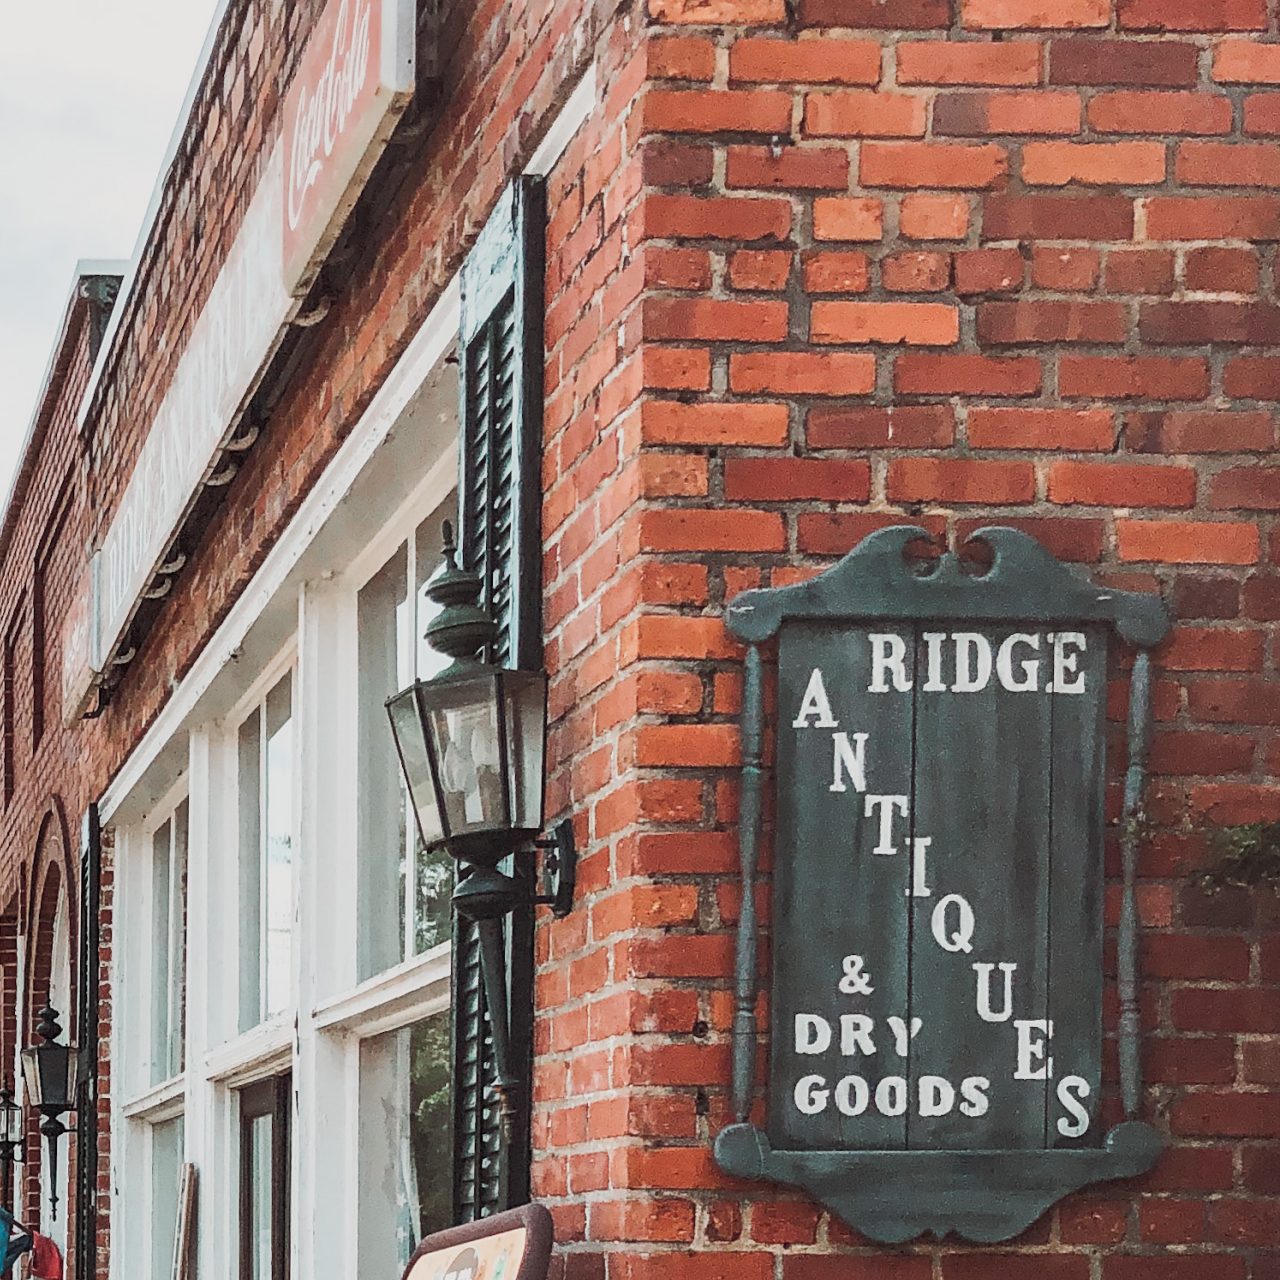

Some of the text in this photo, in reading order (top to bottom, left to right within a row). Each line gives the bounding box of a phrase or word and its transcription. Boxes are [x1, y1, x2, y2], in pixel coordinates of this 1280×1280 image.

[869, 632, 1086, 694] RIDGE
[793, 668, 1090, 1138] ANTIQUES
[838, 955, 874, 995] &
[795, 1014, 922, 1056] DRY
[794, 1075, 990, 1117] GOODS
